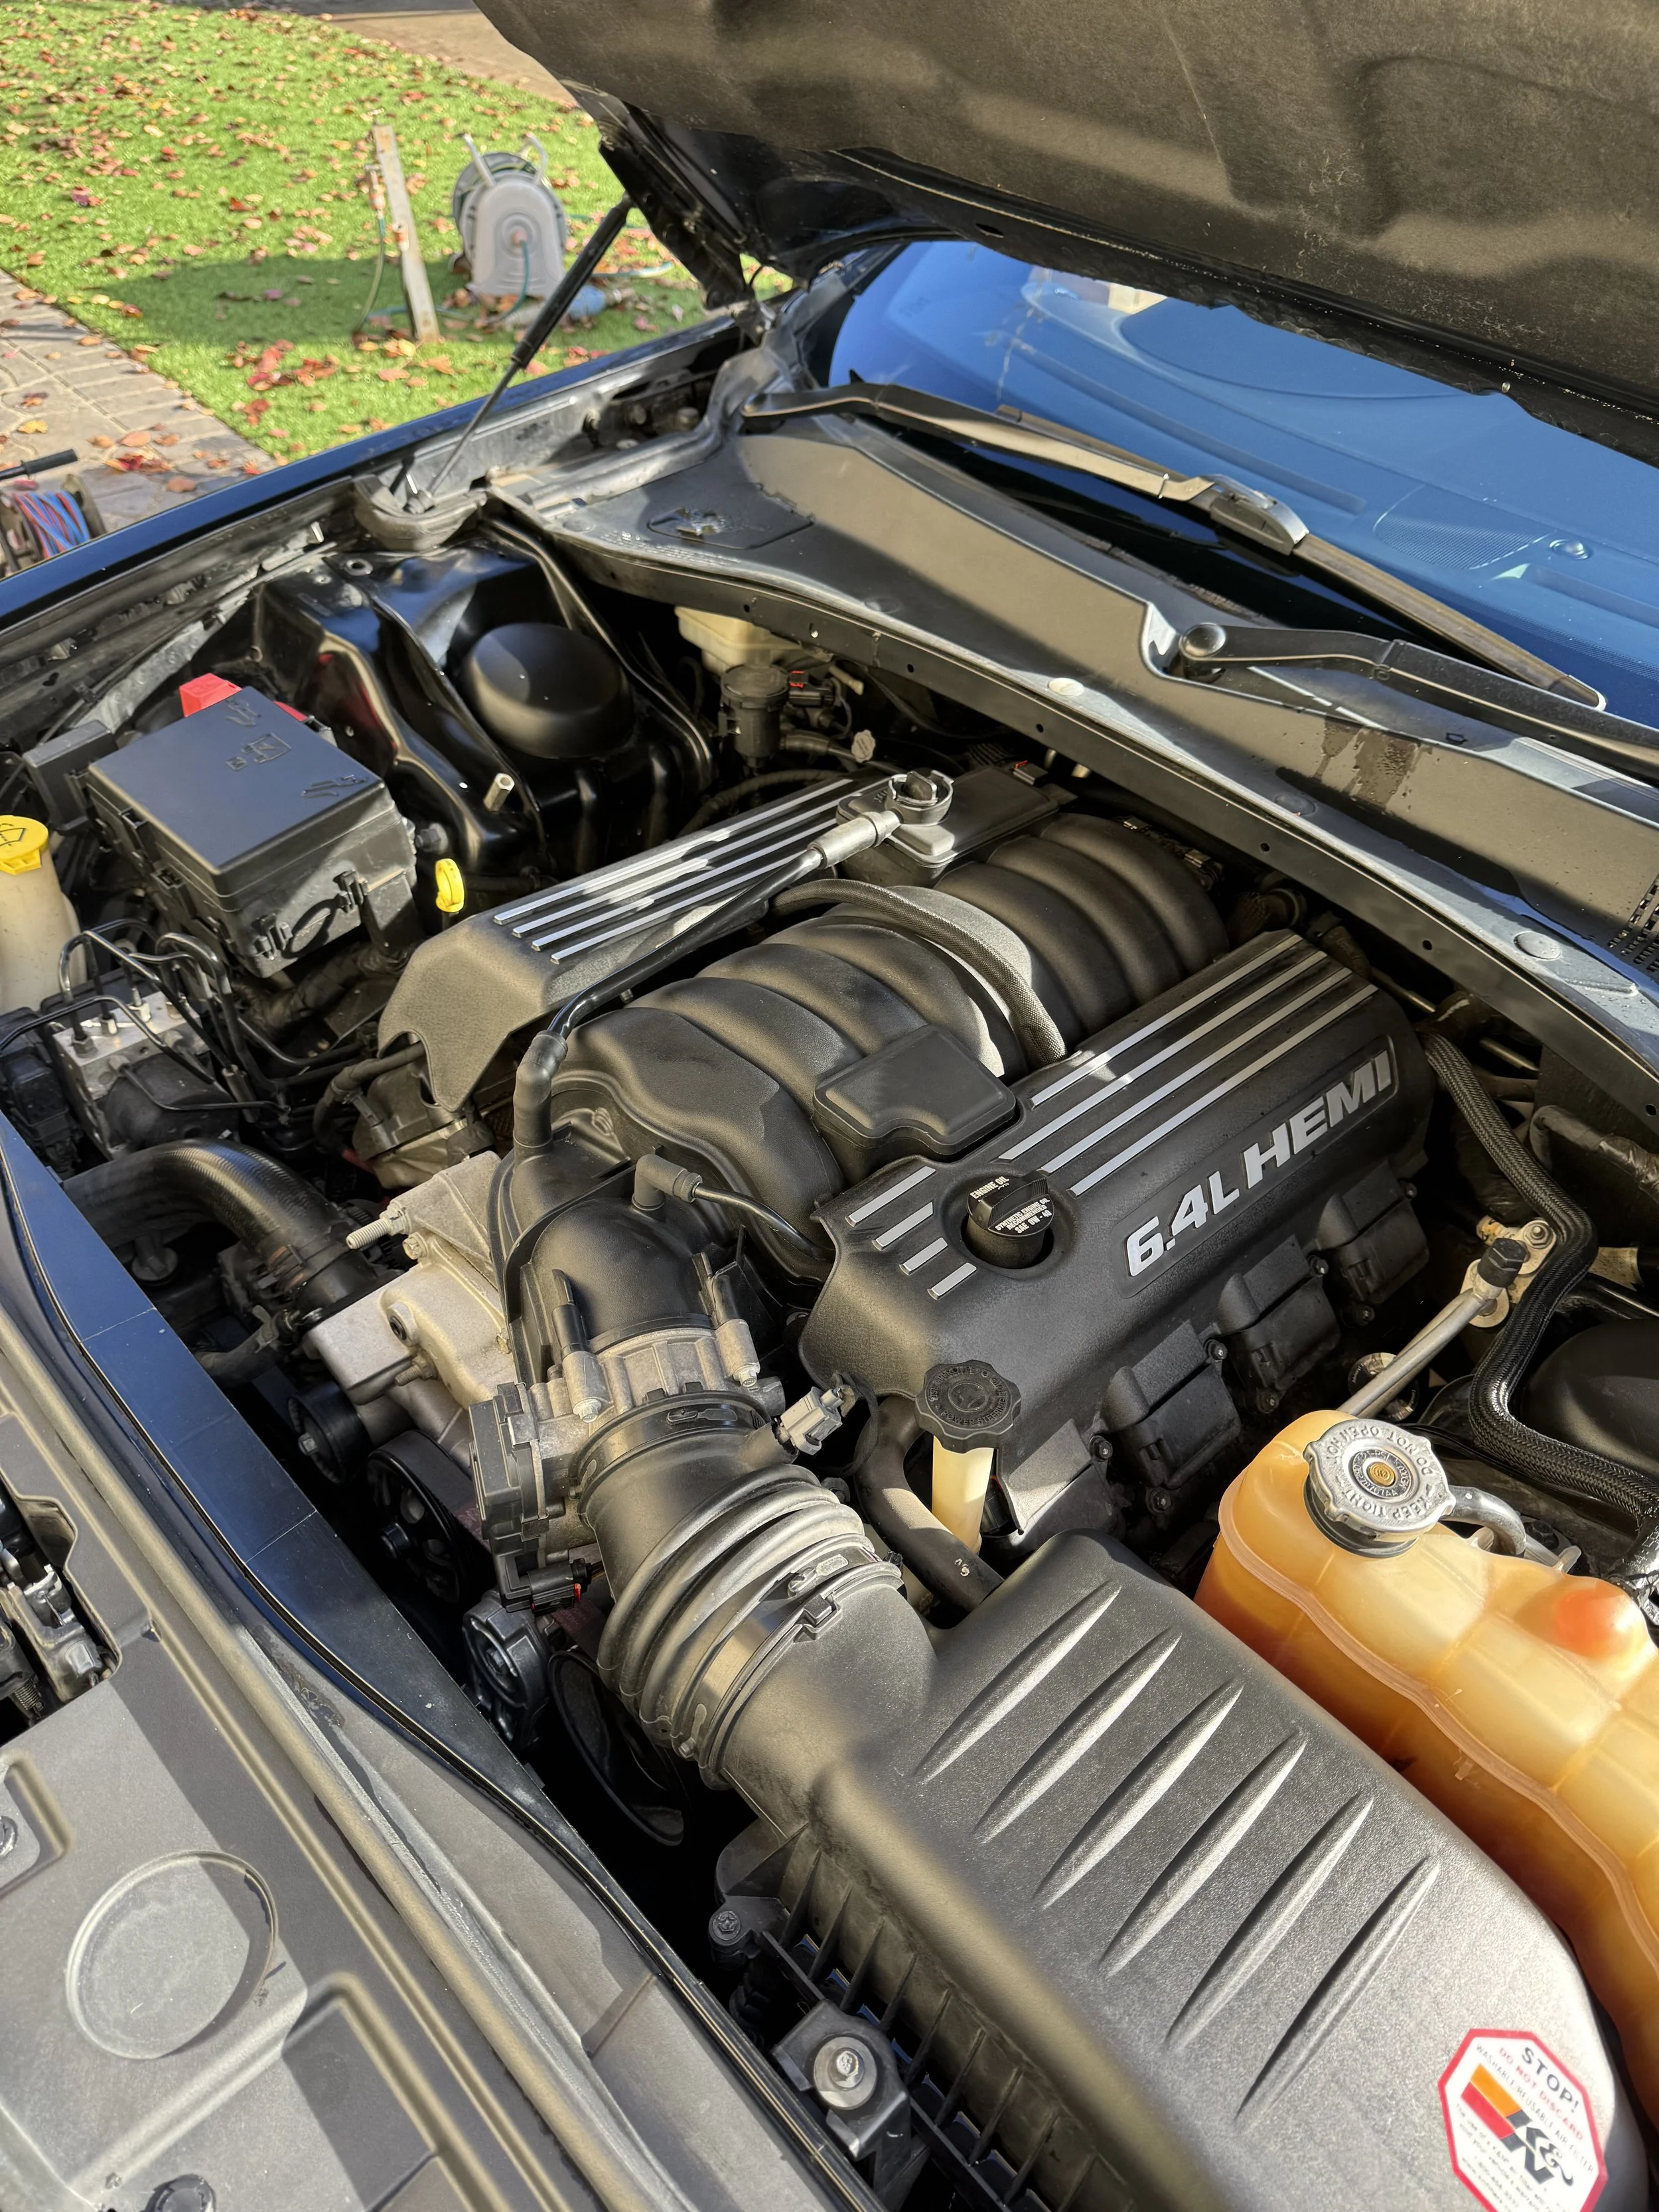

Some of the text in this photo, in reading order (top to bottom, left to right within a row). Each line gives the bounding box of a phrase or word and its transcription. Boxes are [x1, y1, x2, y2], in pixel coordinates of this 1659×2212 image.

[1126, 1050, 1392, 1277] 6.4L HEMI
[970, 1181, 999, 1199] ENGINE
[995, 1176, 1009, 1185] OIL
[995, 1211, 1023, 1231] SYNTHETIC
[1021, 1201, 1042, 1215] ENGINE
[1006, 1205, 1047, 1230] RECOMMENDED
[1015, 1222, 1029, 1234] SAE
[940, 1410, 976, 1426] POWER
[977, 1398, 1006, 1426] STEERING
[1387, 1430, 1420, 1455] NOT
[1416, 1457, 1433, 1475] DO
[1392, 1497, 1433, 1521] KEEP
[1499, 2047, 1584, 2140] DO NOT DISCARD
[1521, 2047, 1579, 2114] STOP!
[1476, 2043, 1594, 2174] WASHABLE/REUSABLE AIR FILTER
